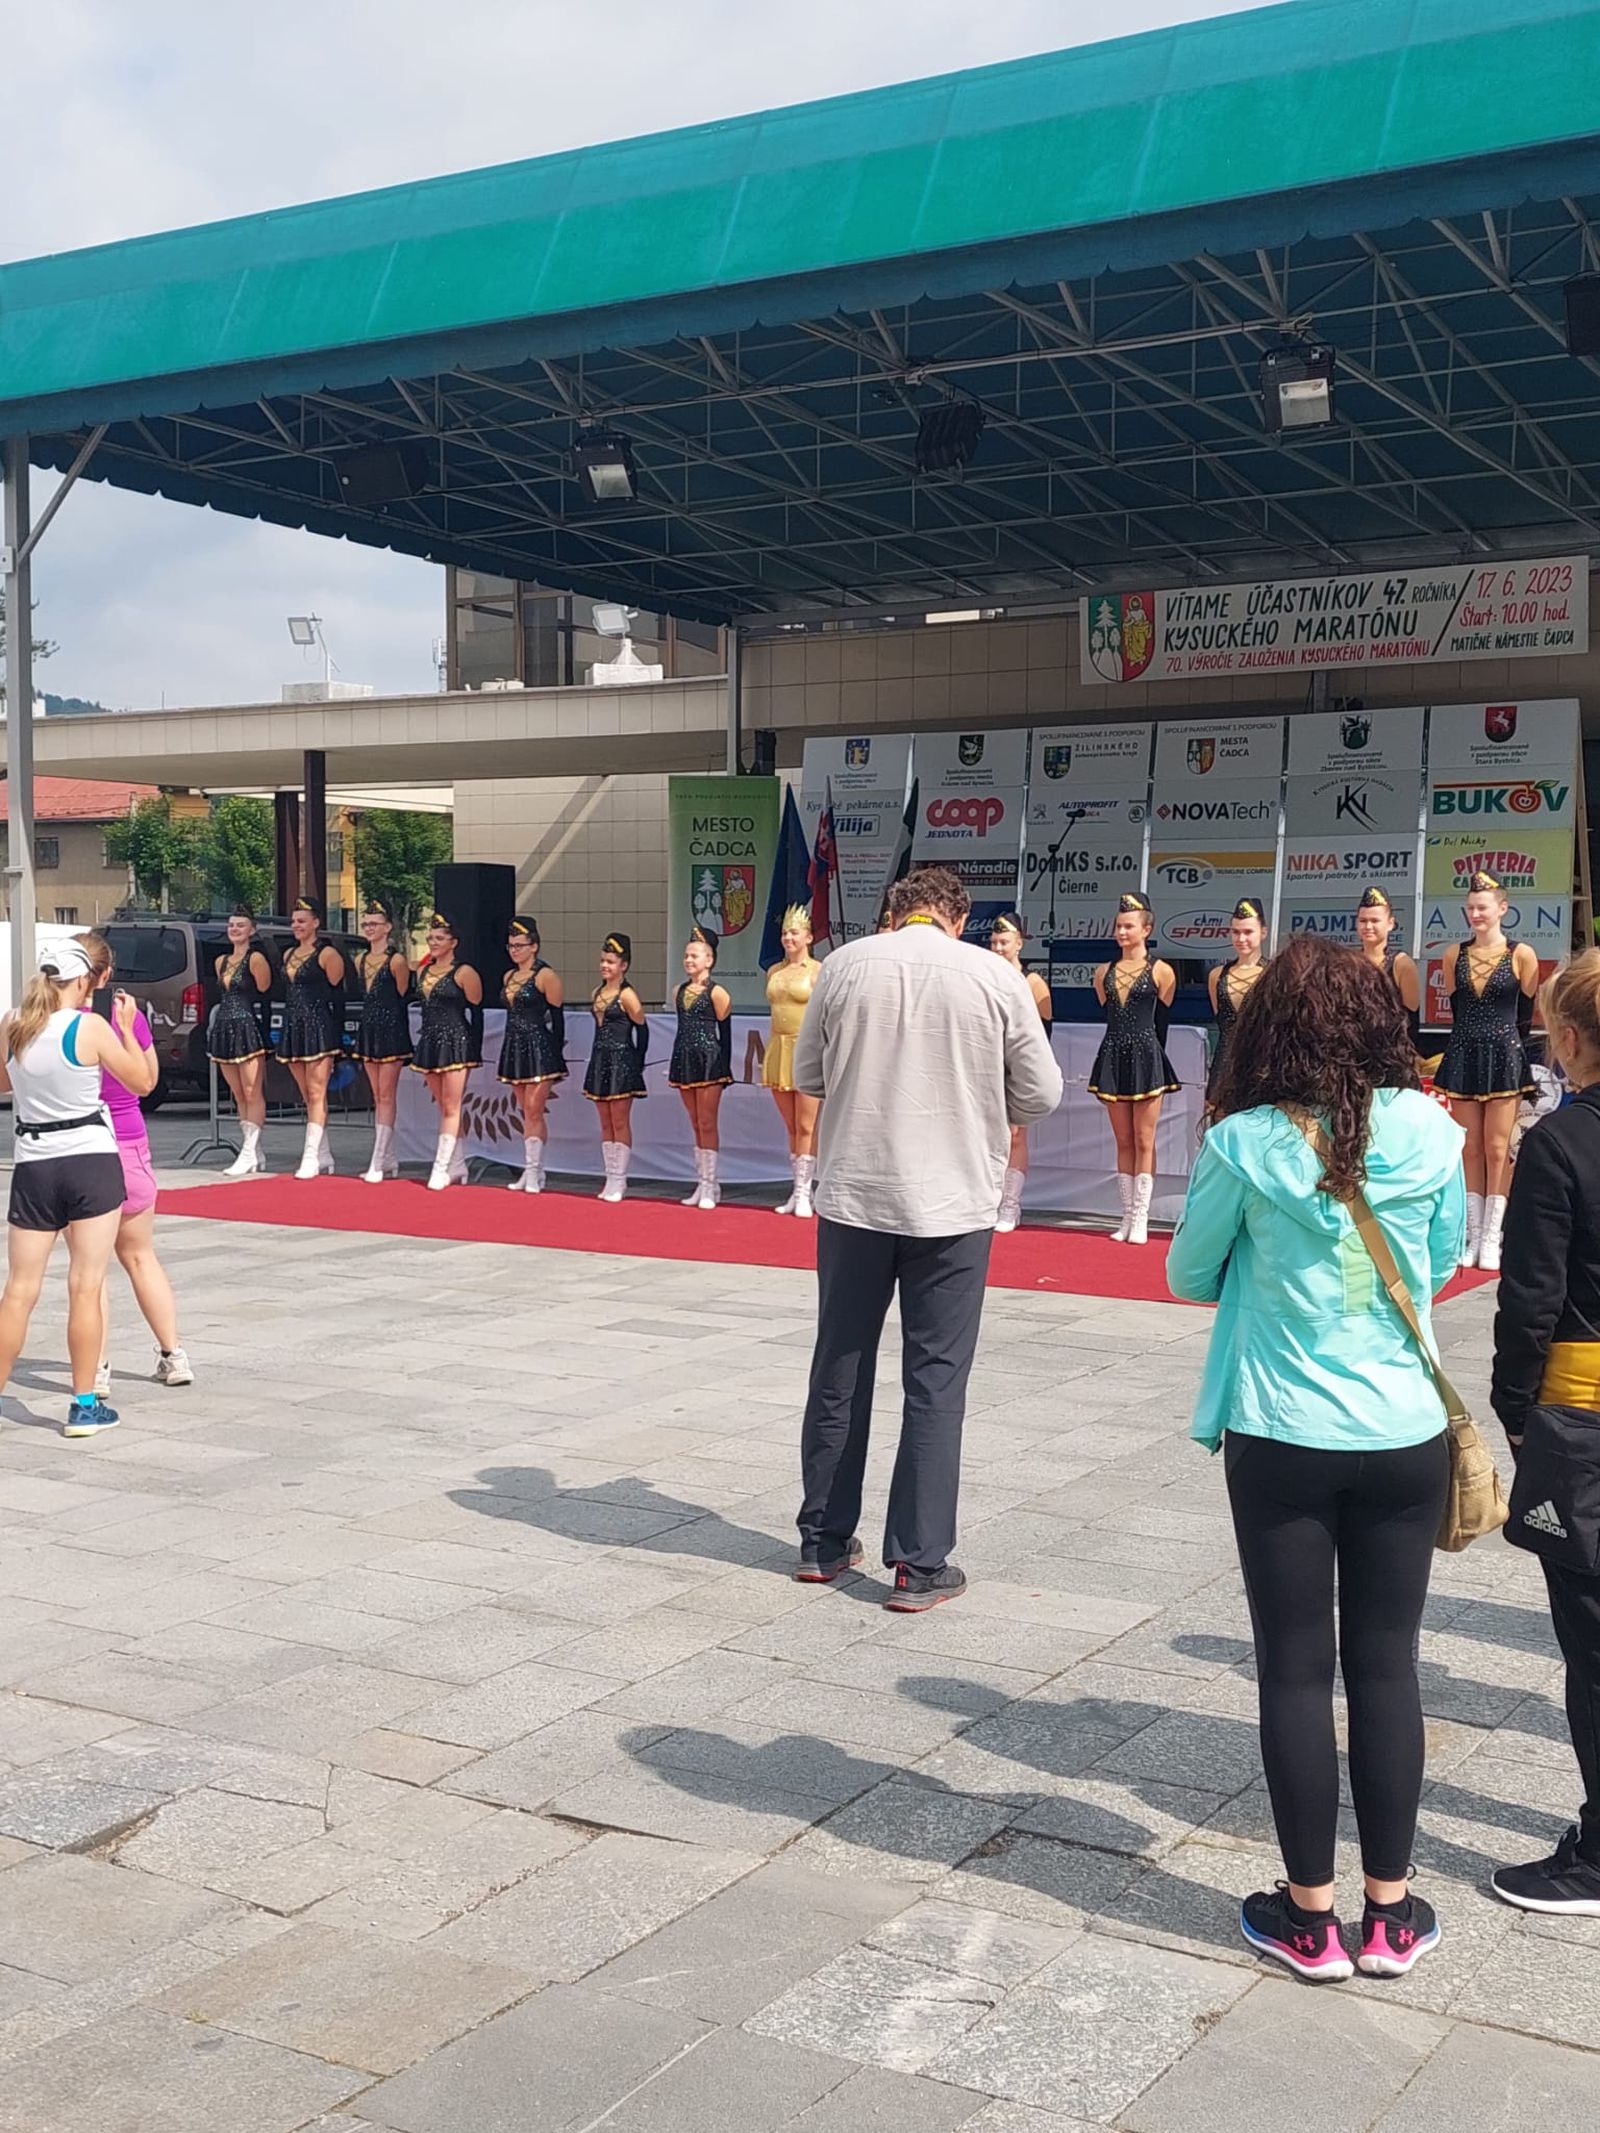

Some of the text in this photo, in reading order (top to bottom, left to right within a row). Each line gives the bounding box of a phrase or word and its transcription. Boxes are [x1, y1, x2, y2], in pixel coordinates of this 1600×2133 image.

[1477, 565, 1572, 599] 17. 6. 2023
[1166, 578, 1456, 622] VÍTAME ÚČASTNÍKOV 47. ROČNÍKA
[1460, 599, 1569, 627] Štart: 10.00 hod.
[1164, 607, 1418, 652] KYSUCKÉHO MARATÓNU
[1166, 637, 1430, 673] 70. VÝROČIE ZALOŽENIA KYSUCKÉHO MARATÓNU
[1220, 737, 1248, 745] MESTA
[806, 799, 842, 812] Kyské
[1433, 785, 1568, 814] BUKOV
[1172, 801, 1269, 820] NOVATech
[692, 817, 754, 833] MESTO
[689, 837, 757, 856] ČADCA
[1095, 854, 1138, 872] s.r.o.
[1287, 851, 1412, 871] NIKA SPORT
[1059, 876, 1098, 893] Čierne
[1166, 868, 1199, 884] TCB
[1170, 927, 1232, 939] SPOR
[1523, 1515, 1567, 1538] adidas
